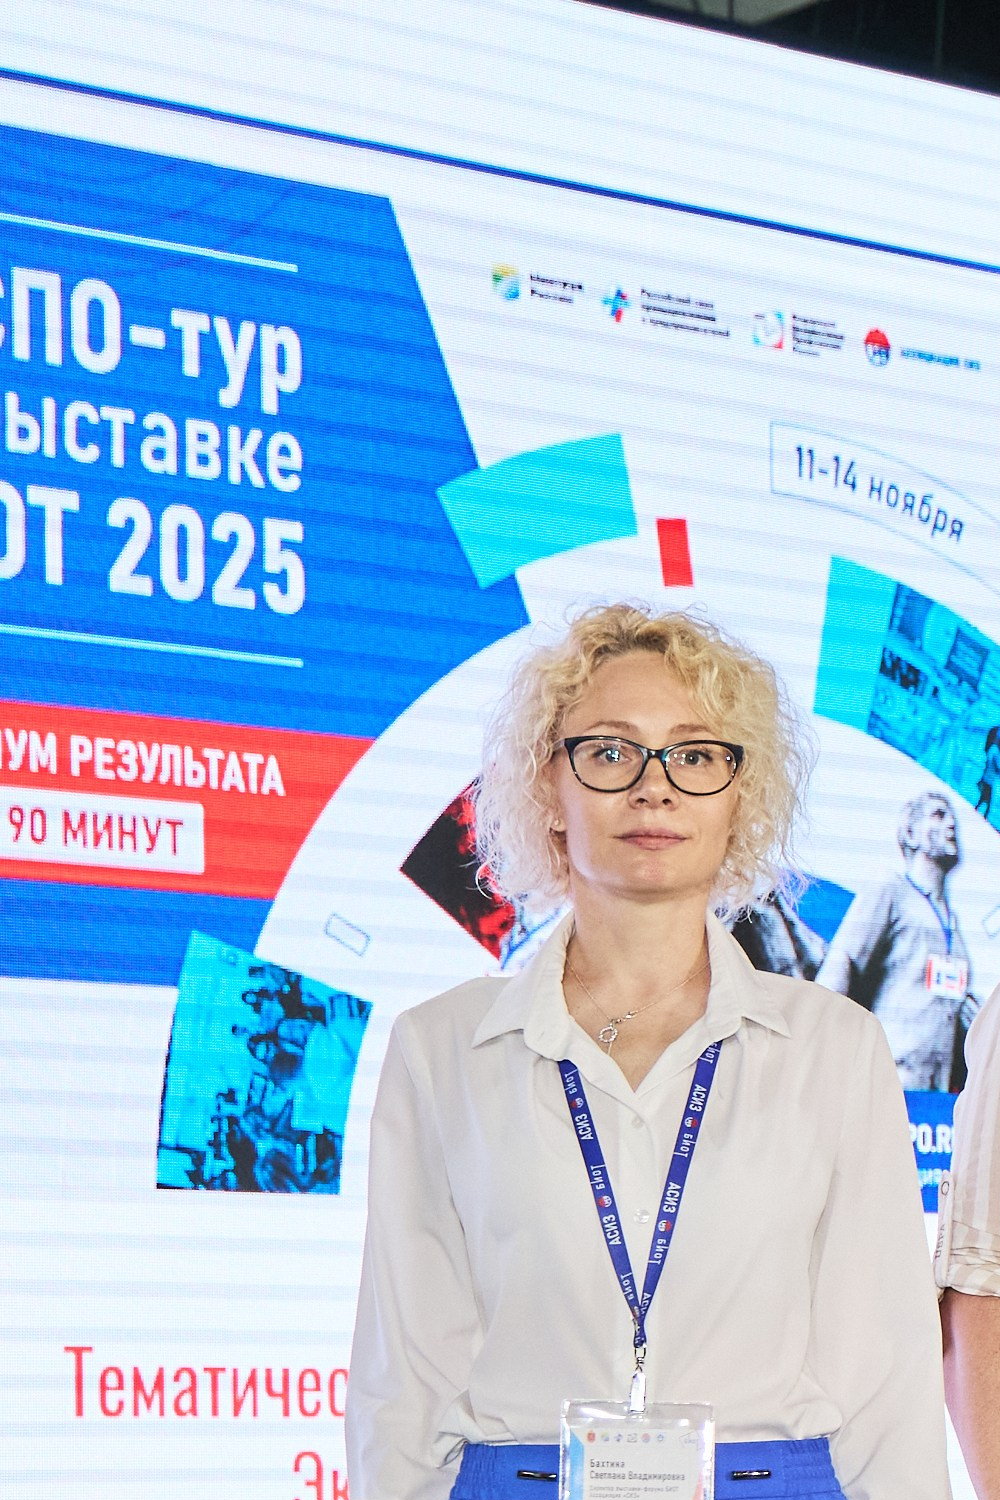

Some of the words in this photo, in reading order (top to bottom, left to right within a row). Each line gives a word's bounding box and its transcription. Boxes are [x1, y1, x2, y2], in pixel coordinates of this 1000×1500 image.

[0, 266, 303, 416] ПО-тур
[796, 444, 857, 492] 11-14
[868, 476, 965, 543] ноября
[107, 497, 306, 615] 2025
[0, 728, 58, 775] УМ
[70, 734, 287, 797] РЕЗУЛЬТАТА
[8, 804, 48, 845] 90
[62, 808, 184, 857] МИНУТ
[688, 1083, 707, 1113] АСИЗ
[574, 1112, 594, 1141] АСИЗ
[662, 1181, 682, 1214] АСИЗ
[602, 1214, 622, 1246] АСИЗ
[63, 1345, 350, 1418] Тематичес
[590, 1459, 625, 1468] Бахтина
[590, 1471, 626, 1479] Светлана
[628, 1471, 685, 1481] Владимировна
